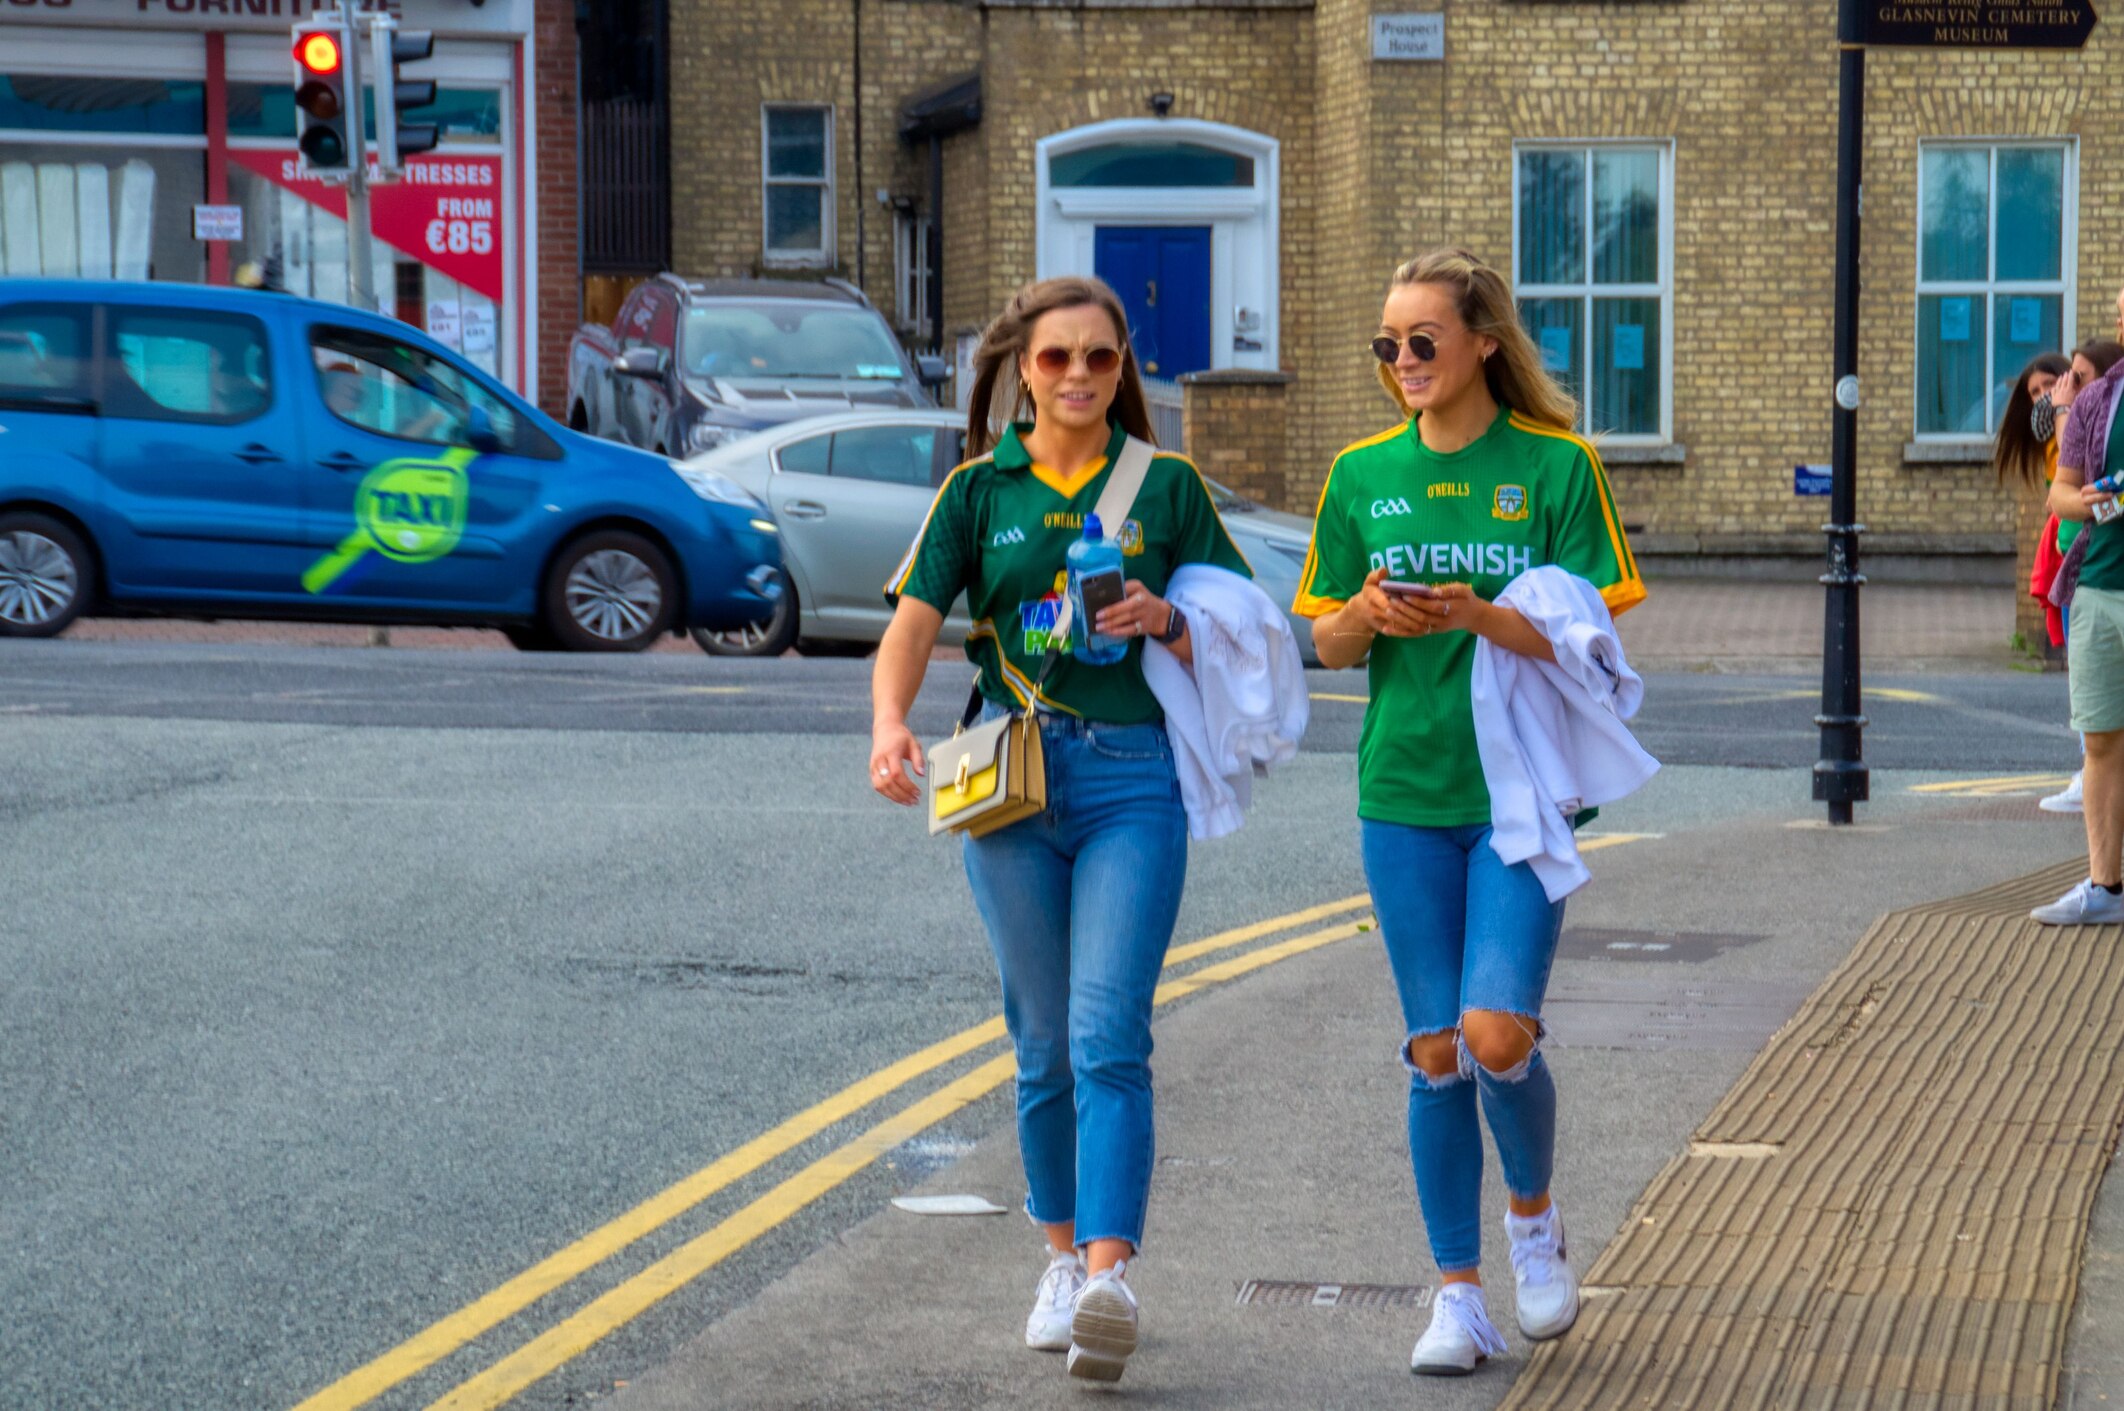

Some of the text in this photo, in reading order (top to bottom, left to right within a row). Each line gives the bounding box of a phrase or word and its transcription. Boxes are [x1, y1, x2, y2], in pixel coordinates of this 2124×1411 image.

[1879, 7, 2081, 25] GLASNEVIN CEMETERY
[1381, 20, 1438, 37] Prospect
[1934, 27, 2009, 43] MUSEUM
[1388, 39, 1429, 53] House
[437, 197, 493, 218] FROM
[425, 219, 493, 254] €85
[1427, 481, 1470, 499] O'NEILLS
[368, 487, 454, 528] TAXI
[1370, 496, 1412, 519] GAA
[1043, 511, 1087, 529] O'NEILL
[1369, 542, 1530, 577] DEVENISH
